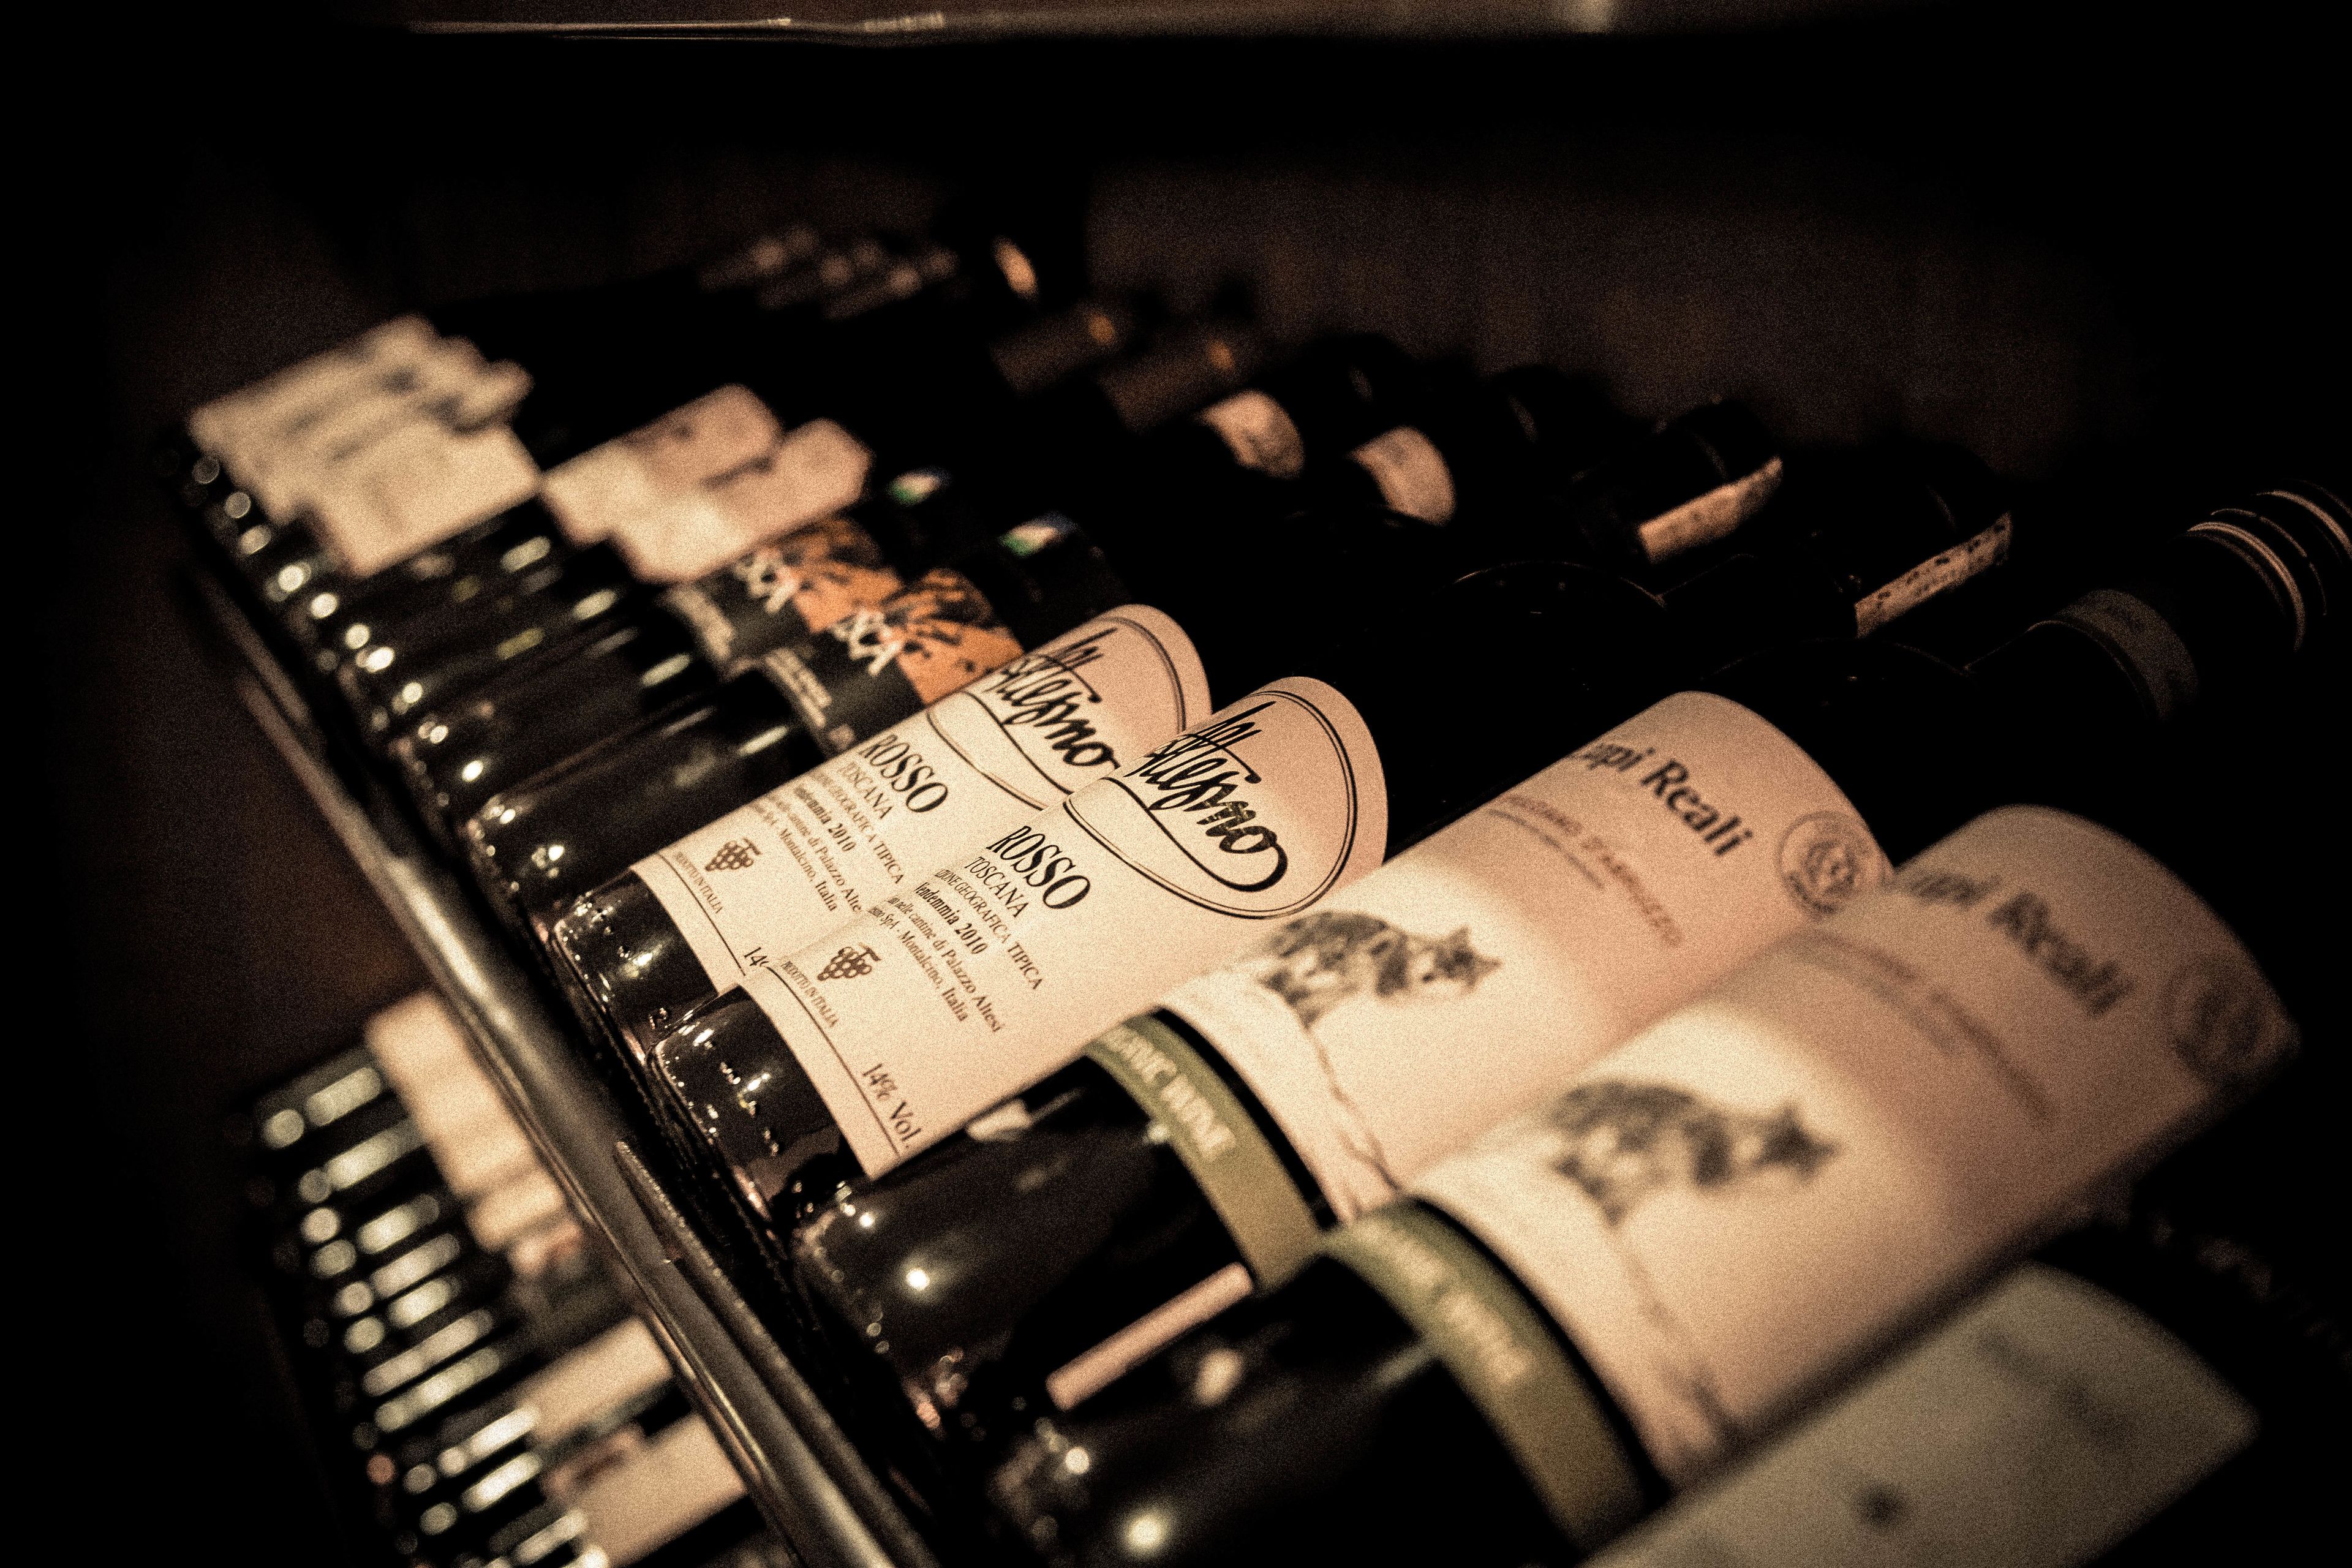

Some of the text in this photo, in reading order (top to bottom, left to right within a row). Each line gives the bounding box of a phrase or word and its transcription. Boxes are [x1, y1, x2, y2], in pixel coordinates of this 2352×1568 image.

[838, 761, 894, 819] TOSCANA
[859, 734, 948, 813] ROSSO
[1642, 760, 1754, 856] Reali
[828, 823, 856, 852] 2010
[874, 841, 904, 884] TIPICA
[815, 846, 846, 886] Palazzo
[842, 888, 862, 914] Alte
[964, 856, 1030, 918] TOSCANA
[986, 825, 1091, 910] ROSSO
[699, 884, 723, 914] ITALIA
[815, 881, 838, 911] Italia
[909, 909, 937, 940] cantine
[933, 938, 947, 951] di
[941, 949, 977, 994] Palazzo
[954, 922, 989, 955] 2010
[955, 881, 1011, 944] GEOGRAFICA
[1008, 941, 1043, 990] TIPICA
[812, 994, 839, 1028] ITALIA
[942, 987, 968, 1022] Italia
[889, 1101, 922, 1150] Vol.
